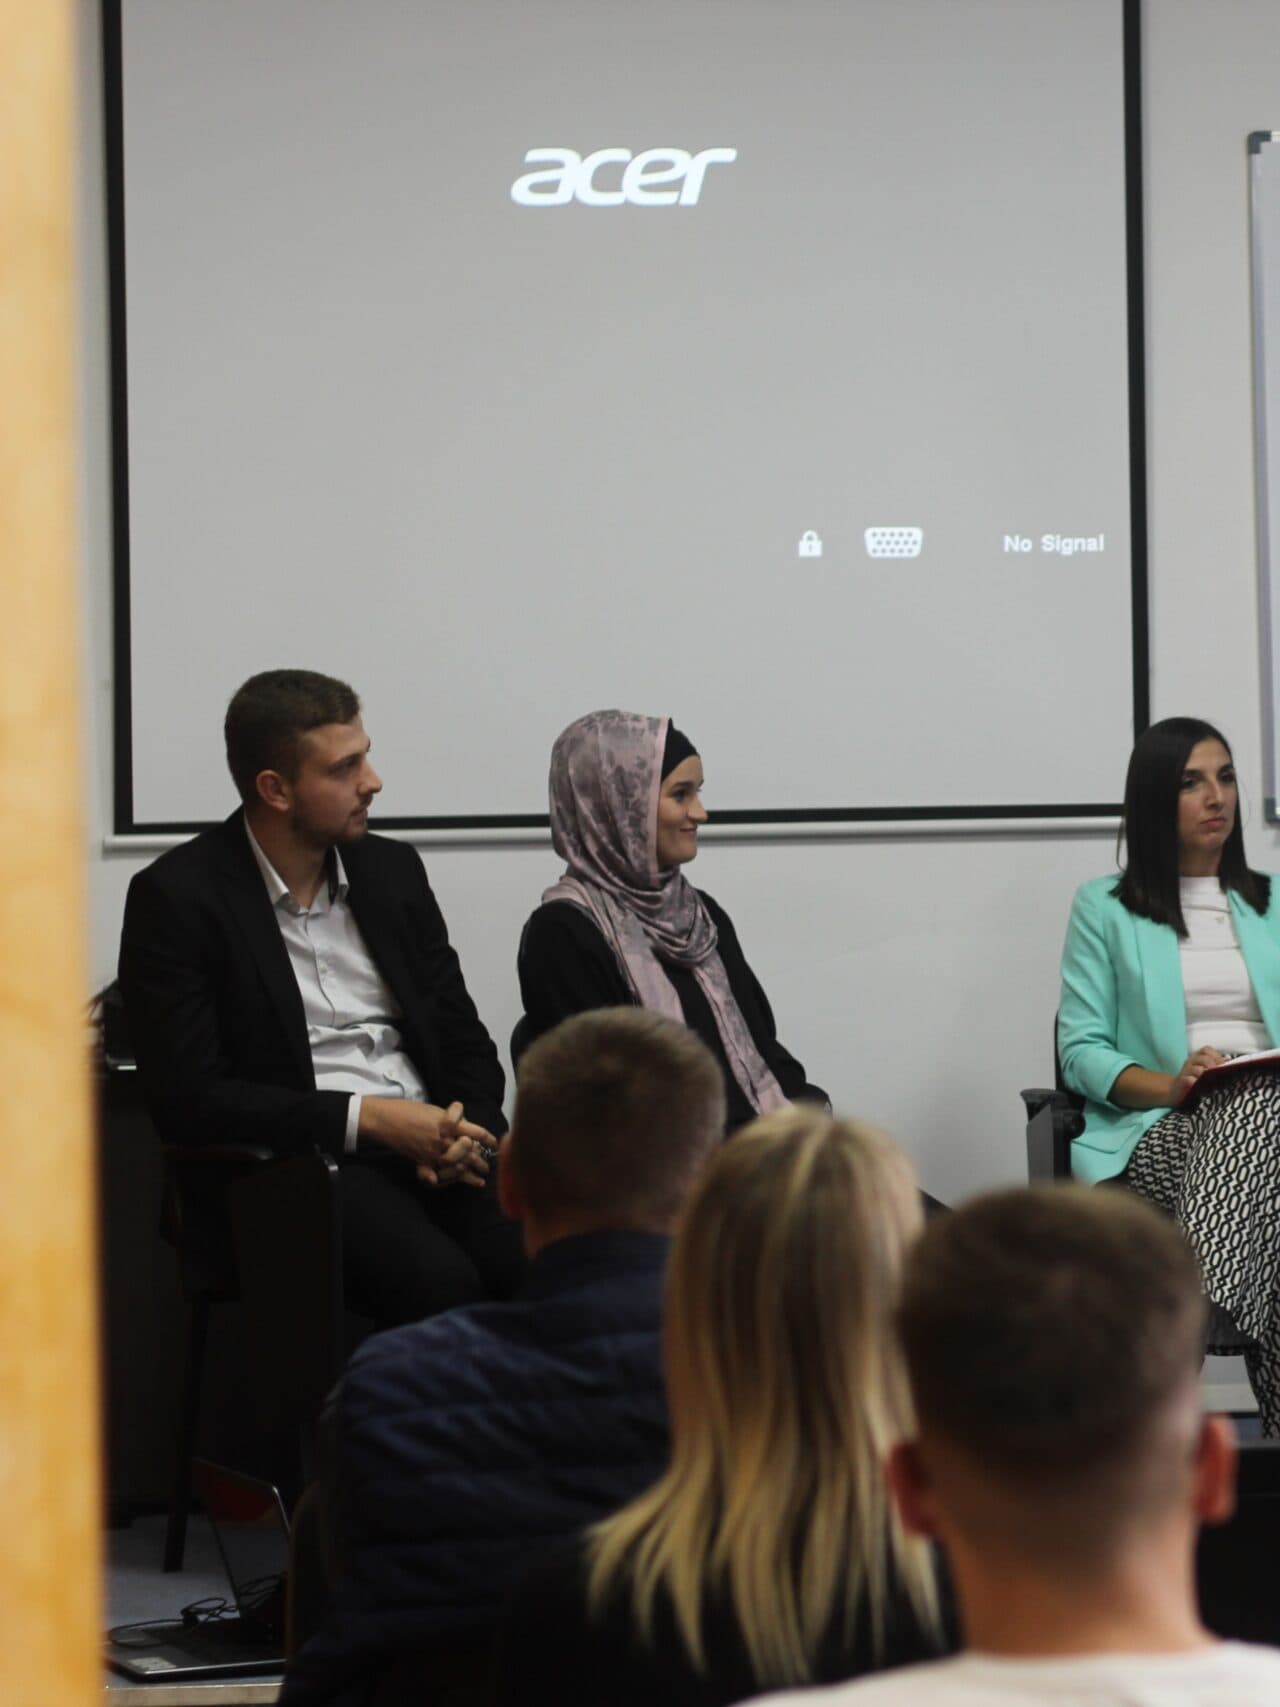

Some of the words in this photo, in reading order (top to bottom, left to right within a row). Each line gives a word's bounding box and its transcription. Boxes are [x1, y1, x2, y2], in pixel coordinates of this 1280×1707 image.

[510, 147, 738, 207] acer
[1003, 534, 1032, 553] No
[1041, 533, 1104, 556] Signal
